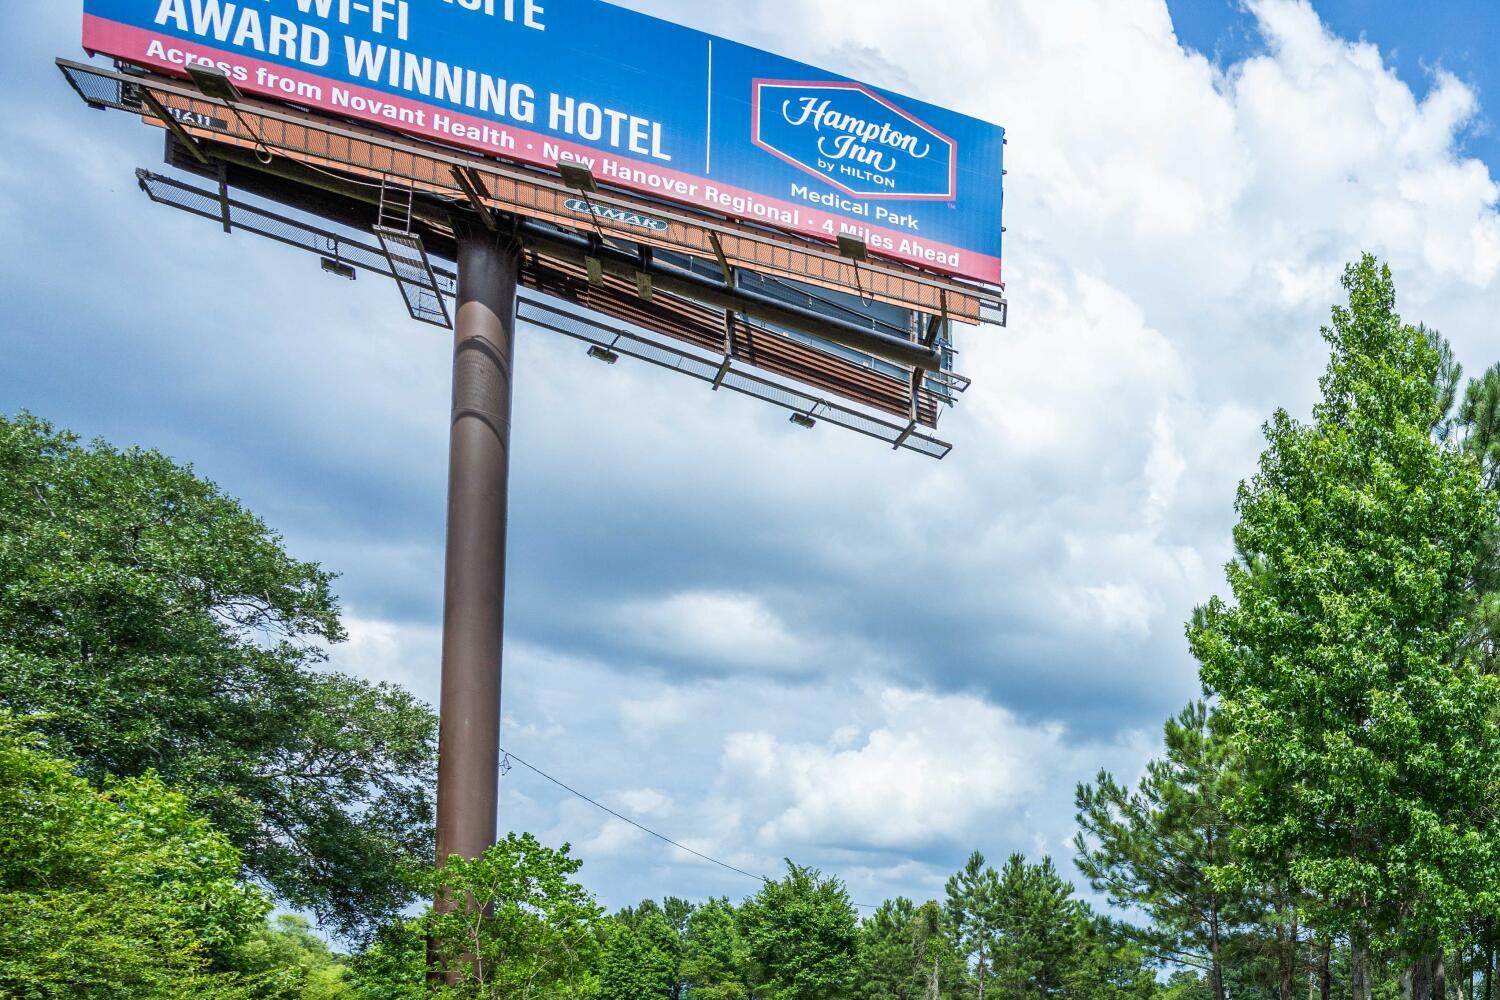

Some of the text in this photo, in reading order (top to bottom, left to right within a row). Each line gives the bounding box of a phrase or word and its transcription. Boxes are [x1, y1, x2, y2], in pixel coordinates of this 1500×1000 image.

[154, 0, 671, 161] AWARD WINNING HOTEL
[782, 96, 930, 158] Hampton
[146, 39, 960, 268] Across from Novant Health New Hanover Regional 4 Miles Ahead
[817, 135, 896, 172] Inn
[817, 158, 895, 189] by HILTON
[573, 201, 658, 230] LAMAR
[791, 183, 919, 230] Medical Park
